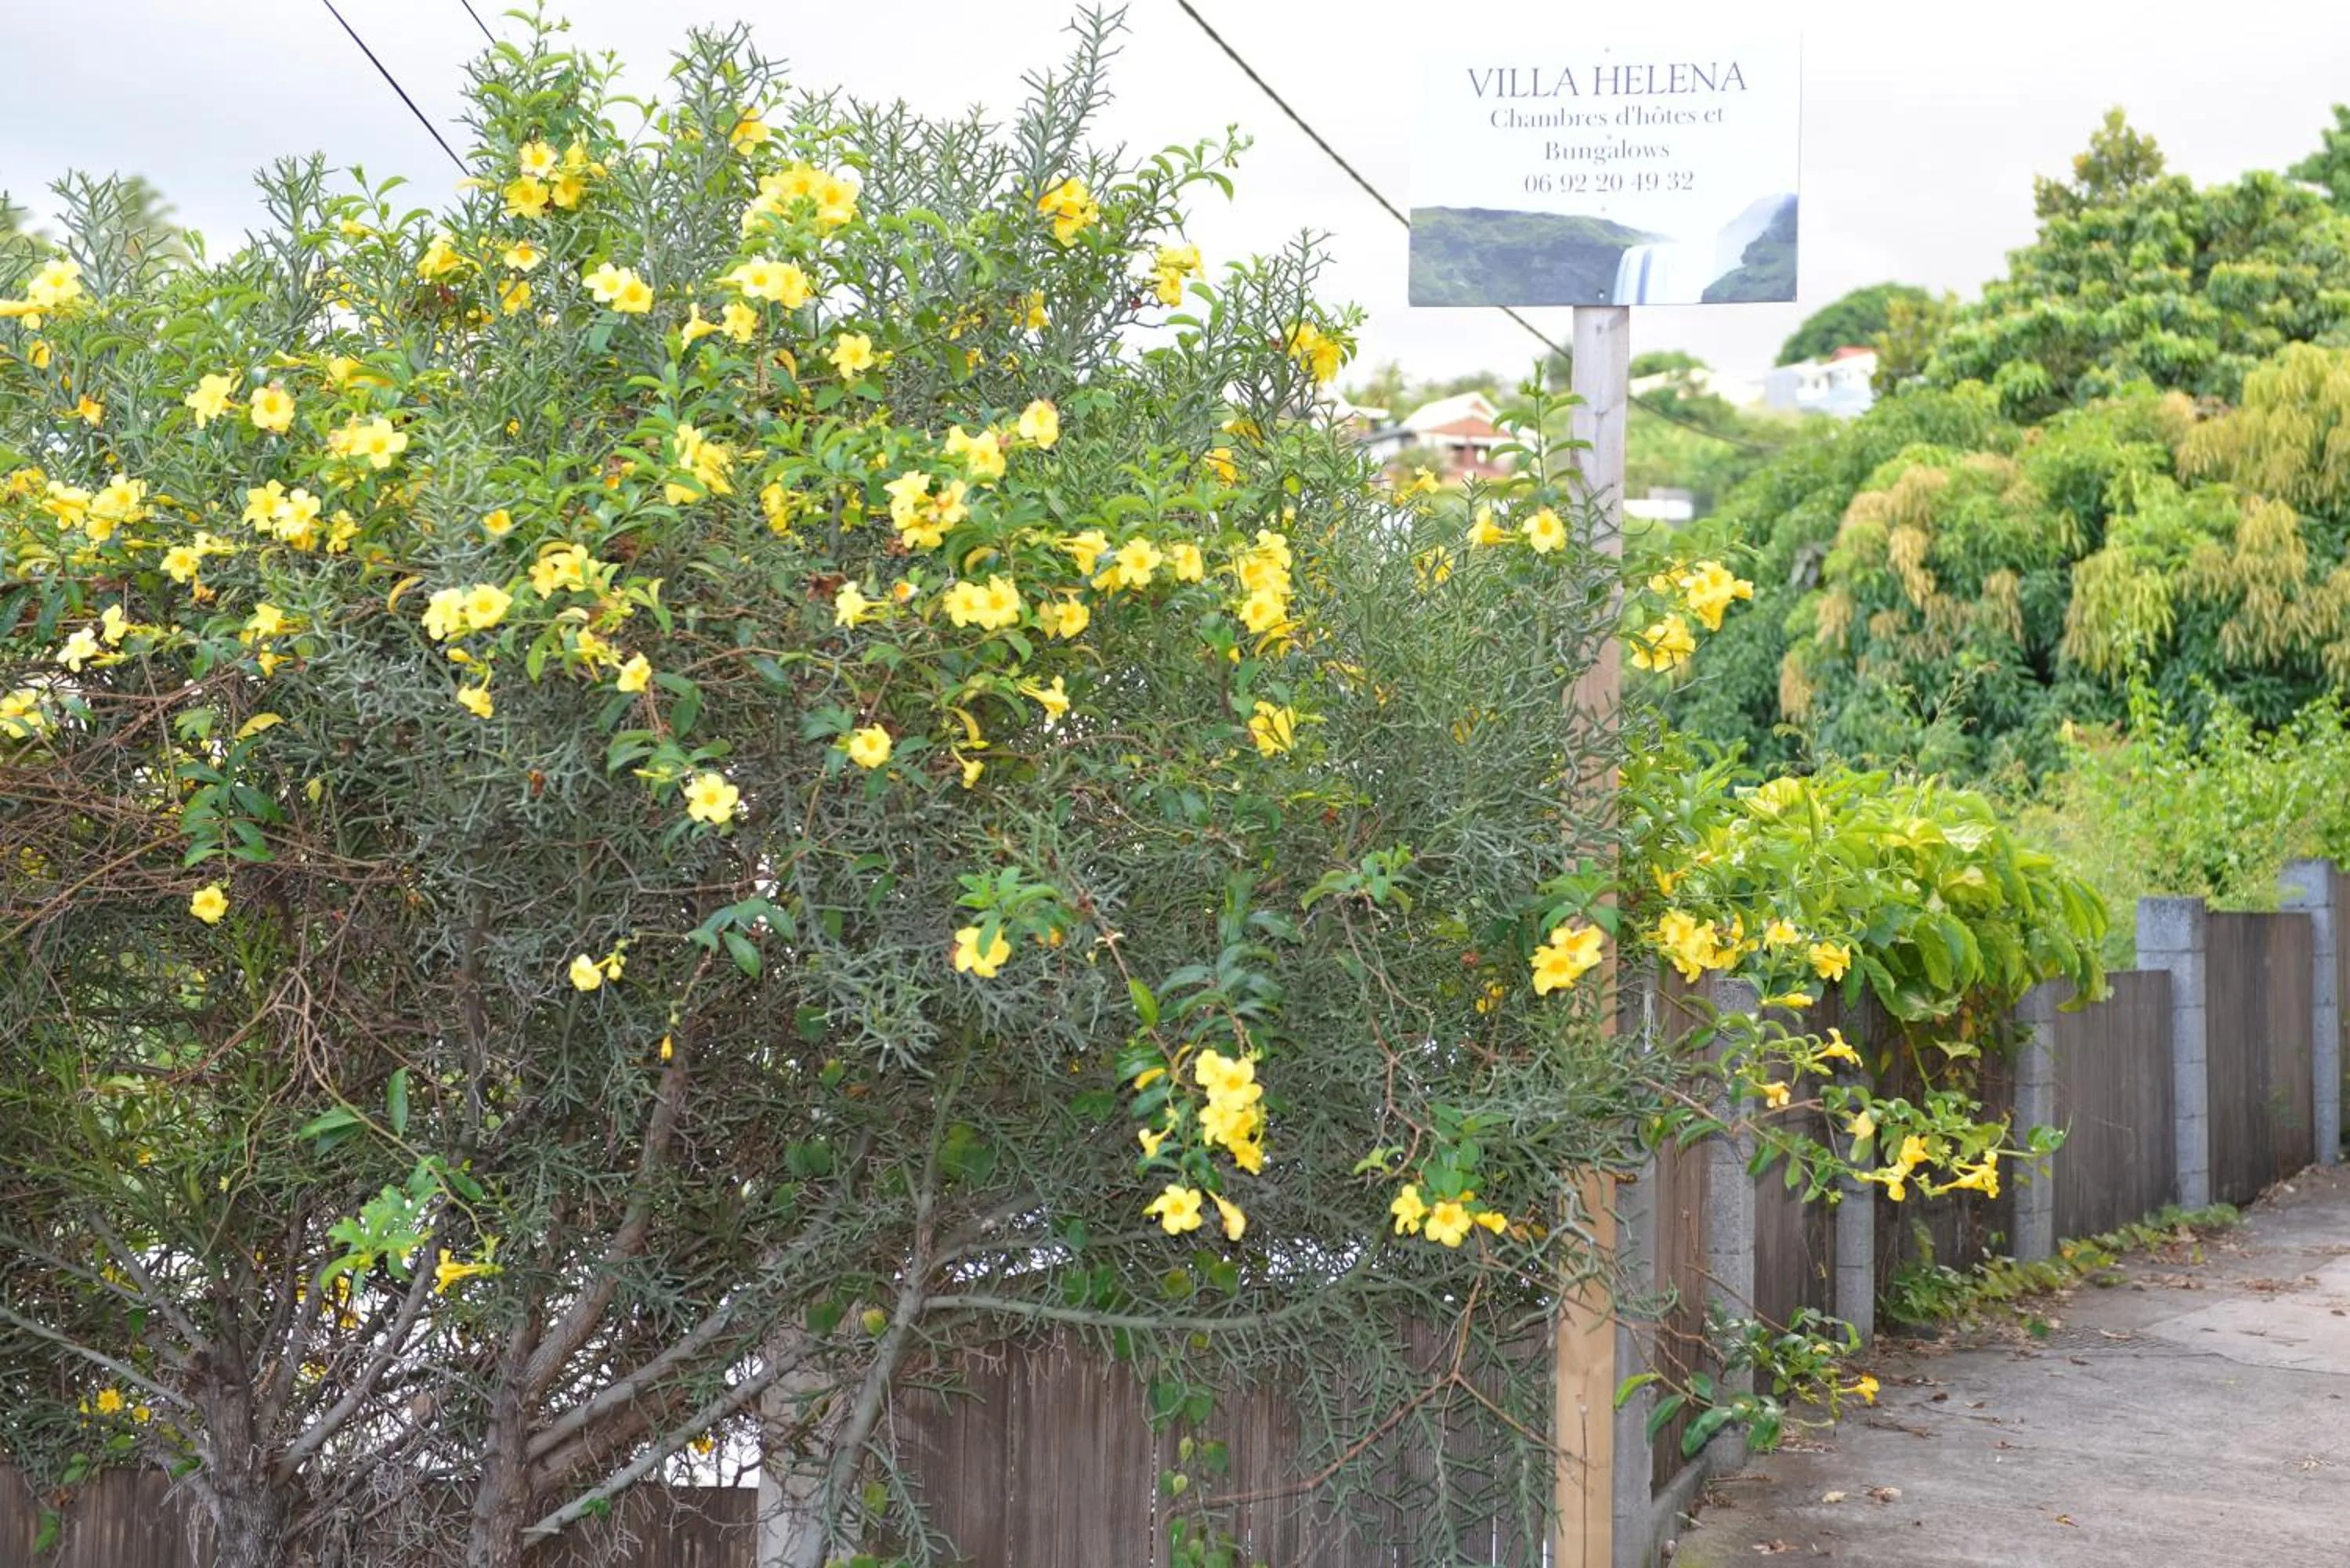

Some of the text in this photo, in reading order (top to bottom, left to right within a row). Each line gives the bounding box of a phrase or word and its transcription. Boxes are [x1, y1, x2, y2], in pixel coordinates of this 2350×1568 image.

[1466, 61, 1748, 99] VILLA HELENA
[1490, 105, 1725, 129] Chambres d'hôtes et
[1545, 139, 1670, 164] Bungalows
[1524, 171, 1694, 193] 06 92 20 49 32
